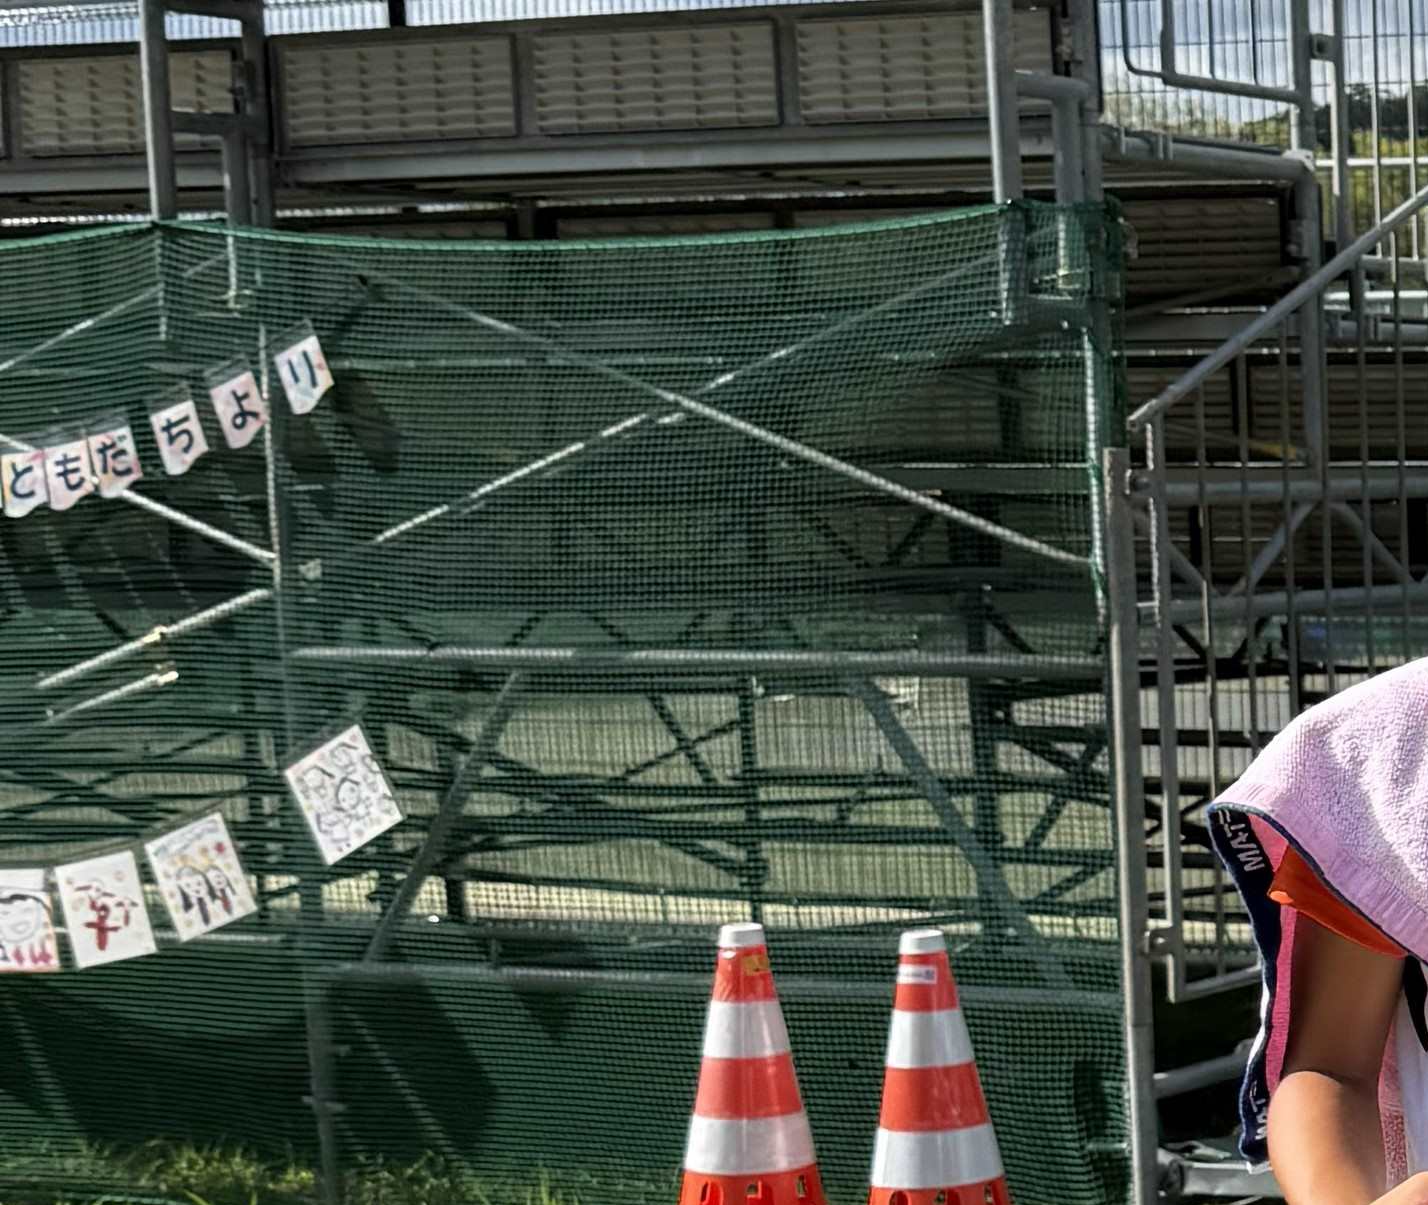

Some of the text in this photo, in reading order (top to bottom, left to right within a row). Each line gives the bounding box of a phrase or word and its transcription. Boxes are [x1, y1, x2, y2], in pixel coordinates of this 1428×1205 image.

[9, 350, 320, 499] ともだちより
